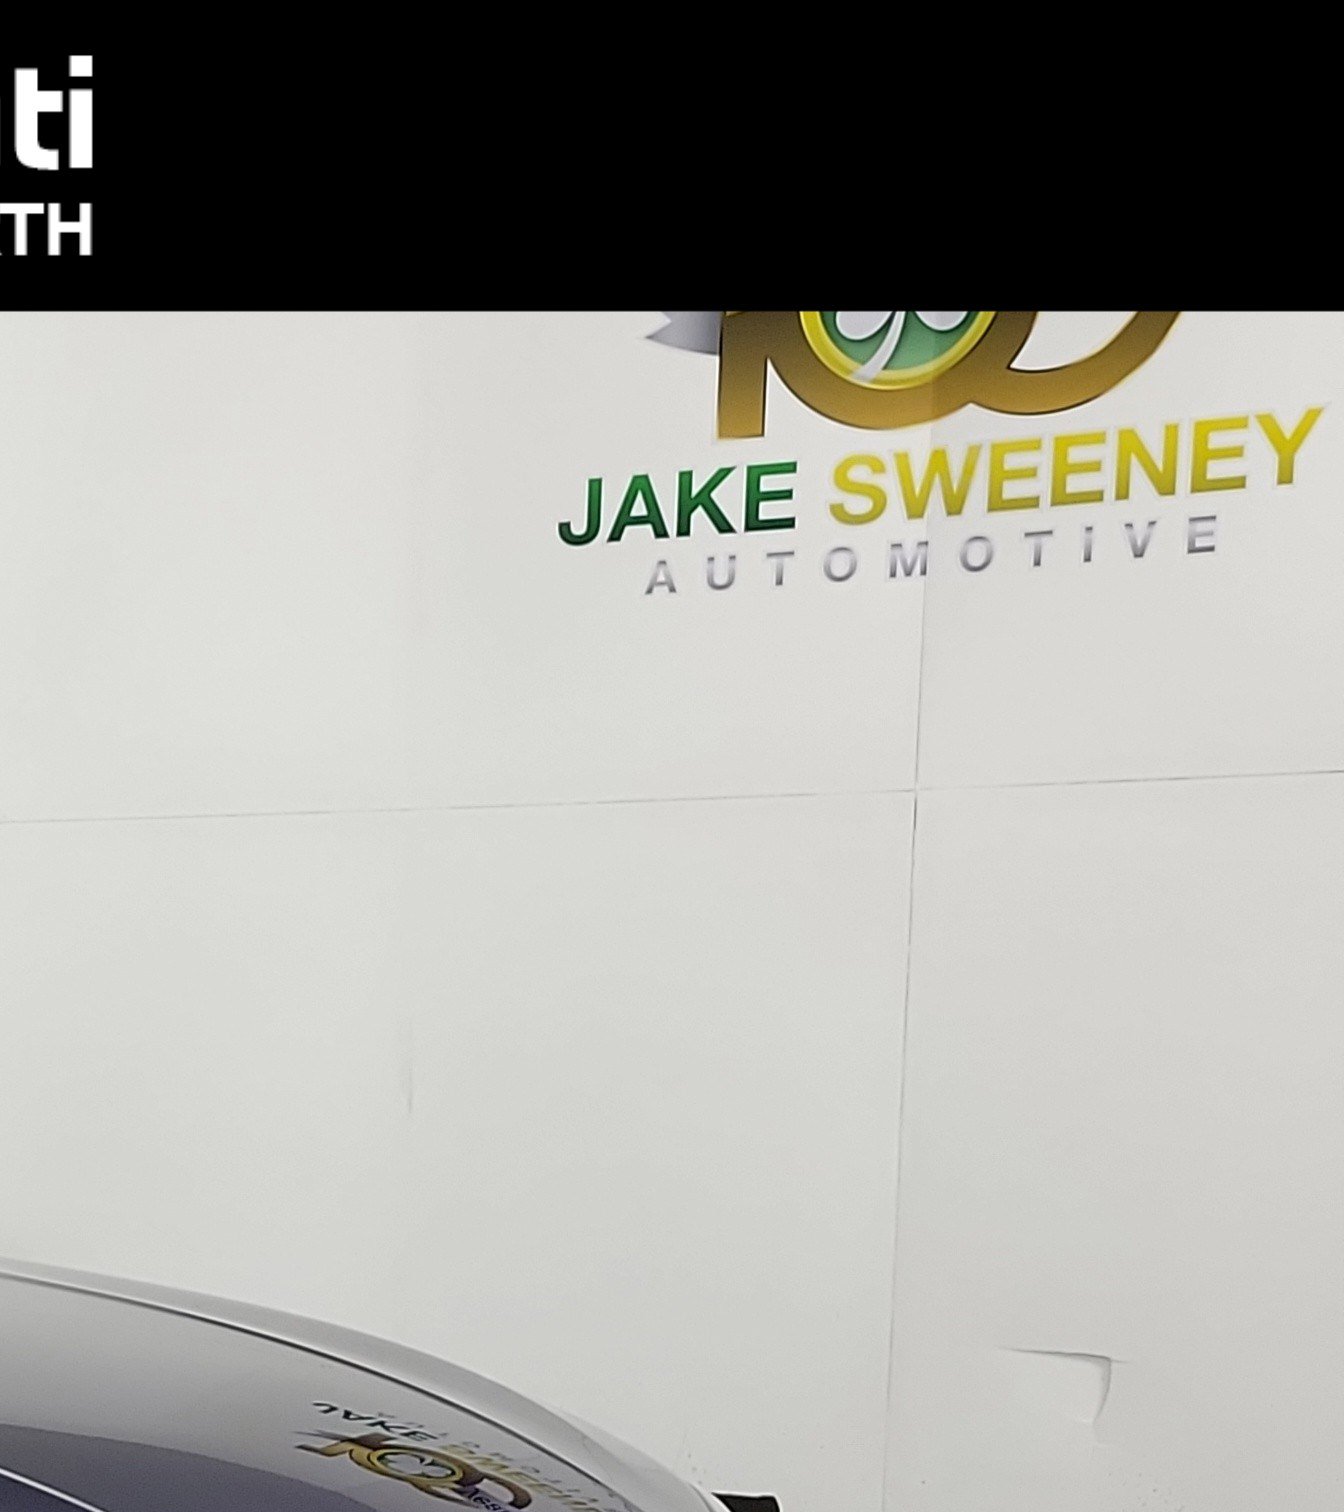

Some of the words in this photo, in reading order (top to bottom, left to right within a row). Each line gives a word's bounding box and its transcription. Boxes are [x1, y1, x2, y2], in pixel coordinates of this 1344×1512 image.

[557, 459, 799, 547] JAKE
[828, 406, 1326, 525] SWEENEY
[644, 515, 1219, 595] AUTOMOTIVE
